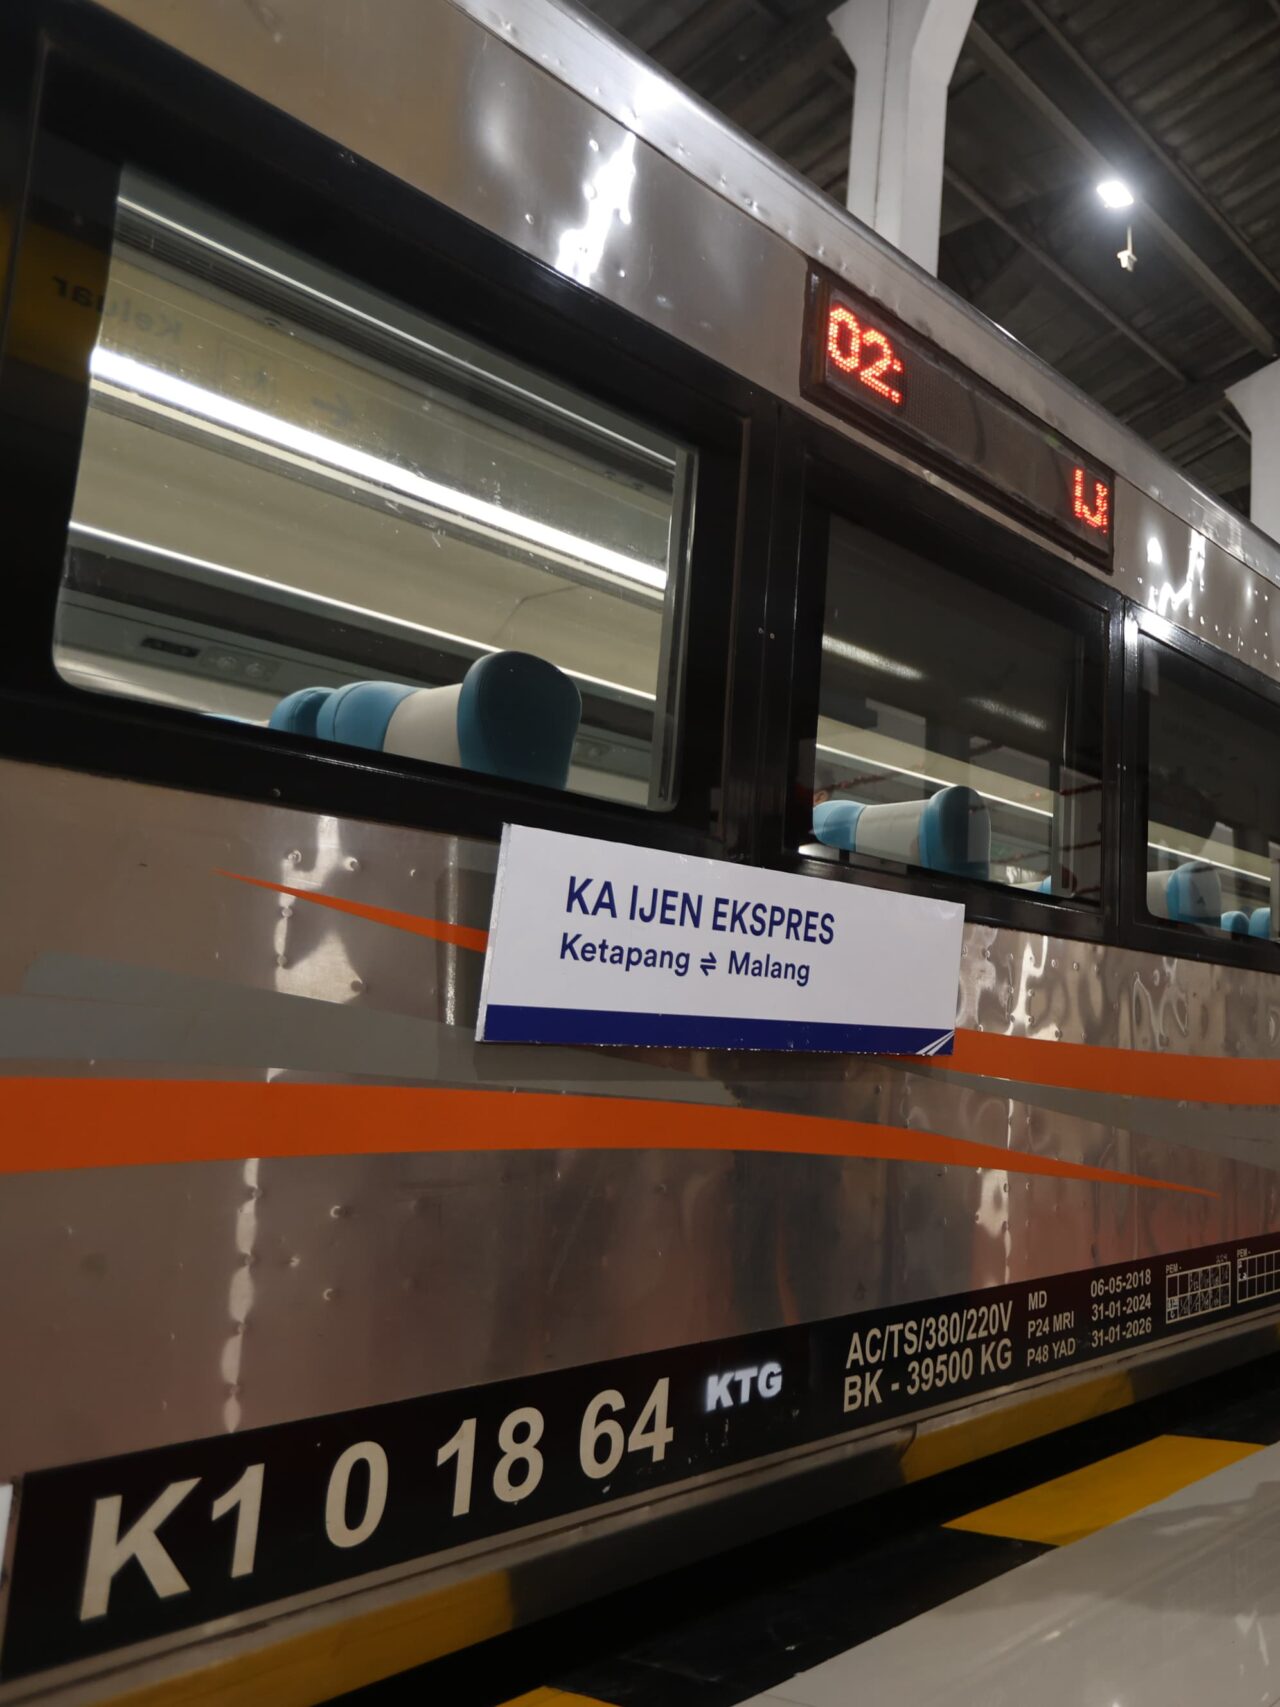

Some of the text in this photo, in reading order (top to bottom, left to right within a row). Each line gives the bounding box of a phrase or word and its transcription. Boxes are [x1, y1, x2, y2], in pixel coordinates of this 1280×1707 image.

[566, 874, 836, 946] KA IJEN EKSPRES
[560, 932, 811, 987] Ketapang Malang
[1028, 1289, 1048, 1311] MD
[1090, 1268, 1152, 1298] 06-05-2018
[1028, 1311, 1075, 1339] P24 MRI
[1091, 1293, 1152, 1322] 31-01-2024
[845, 1300, 1013, 1369] AC/TS/380/220V
[1027, 1337, 1077, 1367] P48 YAD
[1091, 1316, 1152, 1348] 31-01-2026
[706, 1362, 783, 1412] KTG
[843, 1369, 884, 1414] BK
[906, 1348, 973, 1395] 39500
[981, 1338, 1013, 1376] KG
[80, 1377, 674, 1622] K1 0 18 64
